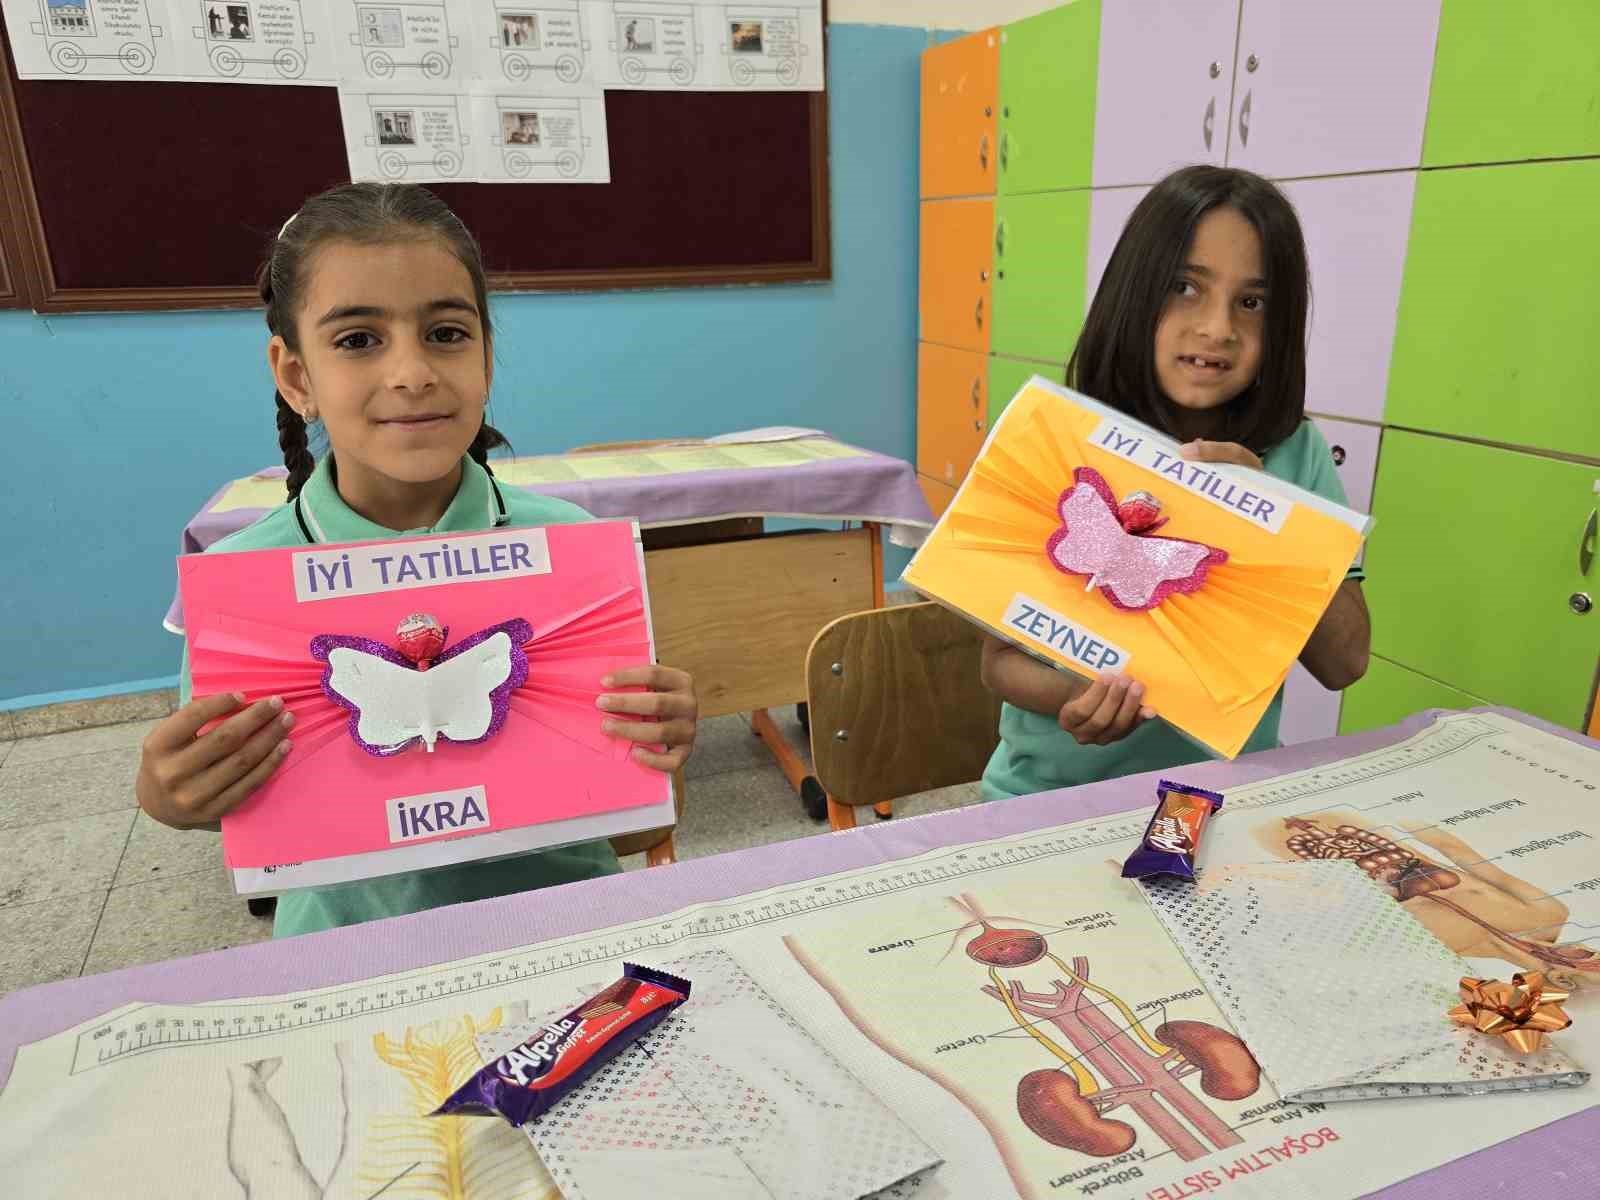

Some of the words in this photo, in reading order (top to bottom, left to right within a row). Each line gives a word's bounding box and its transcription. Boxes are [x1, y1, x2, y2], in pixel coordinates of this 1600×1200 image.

[1101, 426, 1141, 458] İYİ
[1150, 451, 1276, 523] TATİLLER
[306, 554, 353, 594] İYİ
[372, 542, 534, 588] TATİLLER
[1011, 603, 1120, 671] ZEYNEP
[398, 796, 486, 838] İKRA
[868, 938, 915, 955] Üretra
[1136, 988, 1204, 1012] Böbrekler
[507, 1018, 576, 1086] Alpella
[556, 1025, 587, 1054] Gofret
[934, 1033, 987, 1055] Üreter
[1271, 1110, 1303, 1125] Ana
[1220, 1127, 1341, 1180] BOŞALTIM
[1081, 1166, 1144, 1195] Böbrek
